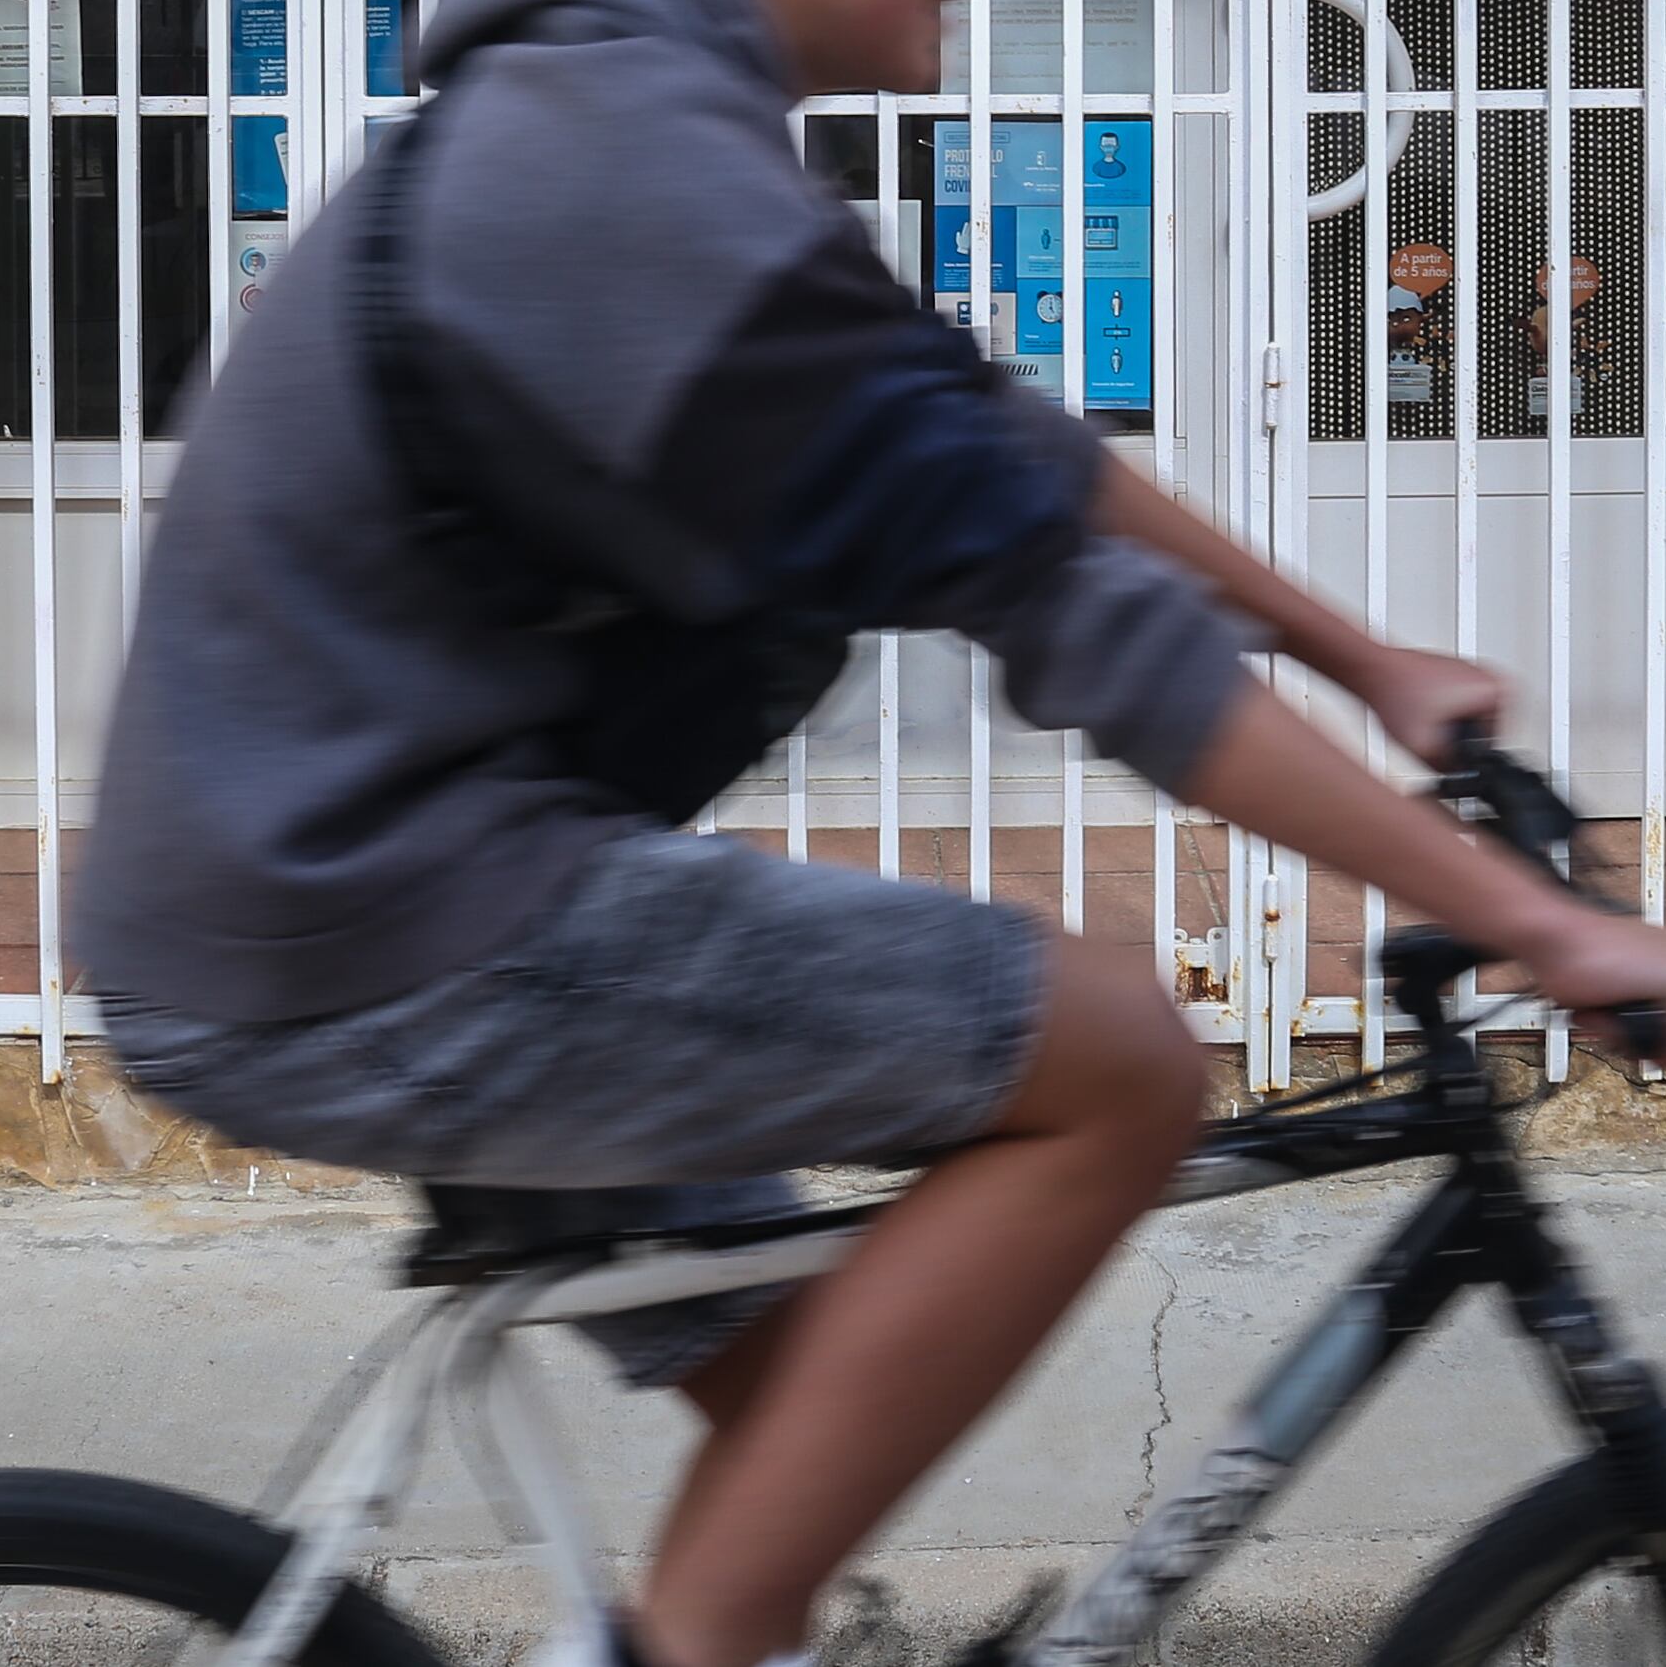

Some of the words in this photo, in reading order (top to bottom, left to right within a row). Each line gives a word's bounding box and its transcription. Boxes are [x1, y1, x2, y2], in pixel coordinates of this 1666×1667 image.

[1400, 253, 1410, 264] A
[1412, 252, 1442, 266] partir
[1393, 266, 1408, 278] de
[1410, 266, 1420, 277] 5
